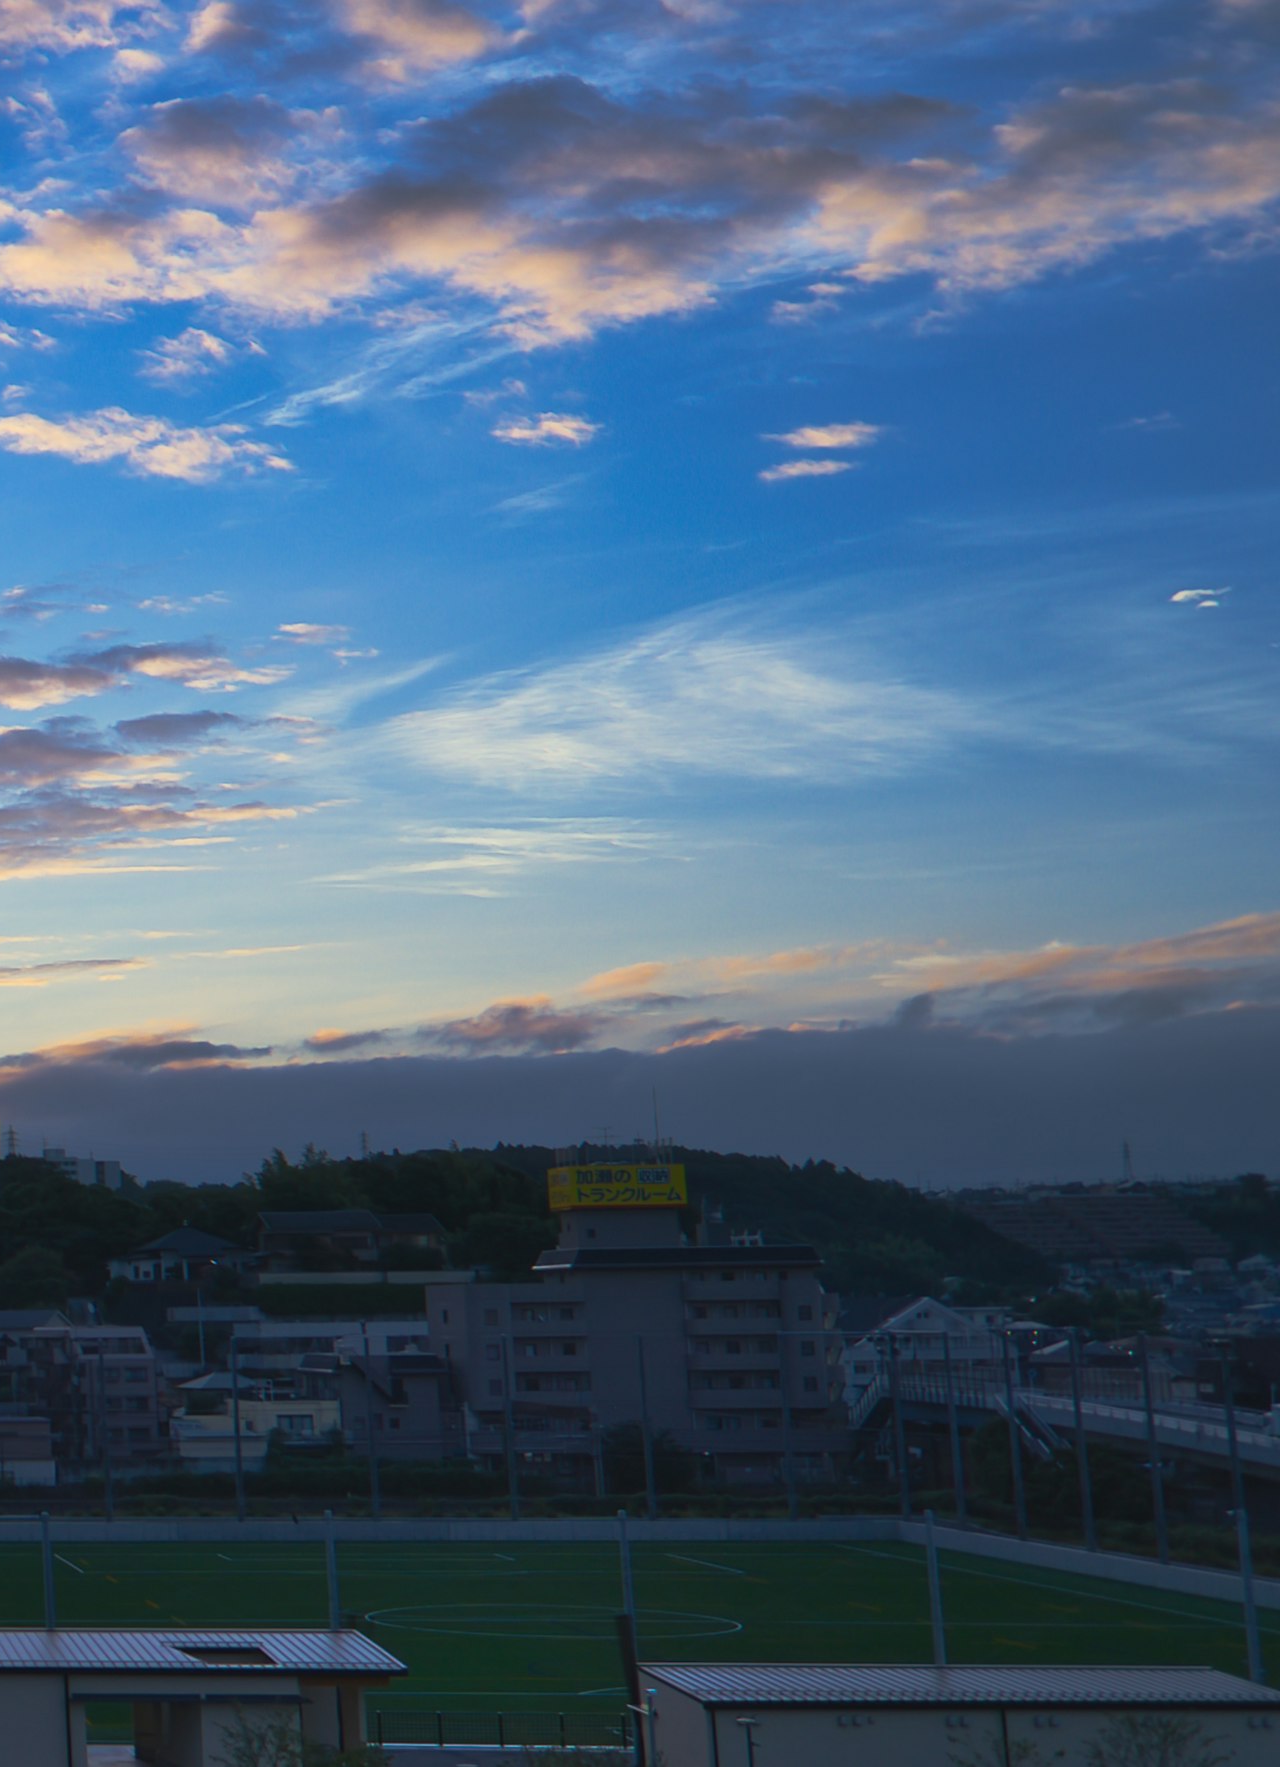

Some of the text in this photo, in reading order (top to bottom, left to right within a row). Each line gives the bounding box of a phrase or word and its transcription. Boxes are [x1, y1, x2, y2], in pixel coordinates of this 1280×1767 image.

[576, 1169, 631, 1185] 加瀬の
[576, 1187, 682, 1202] トランクルーム
